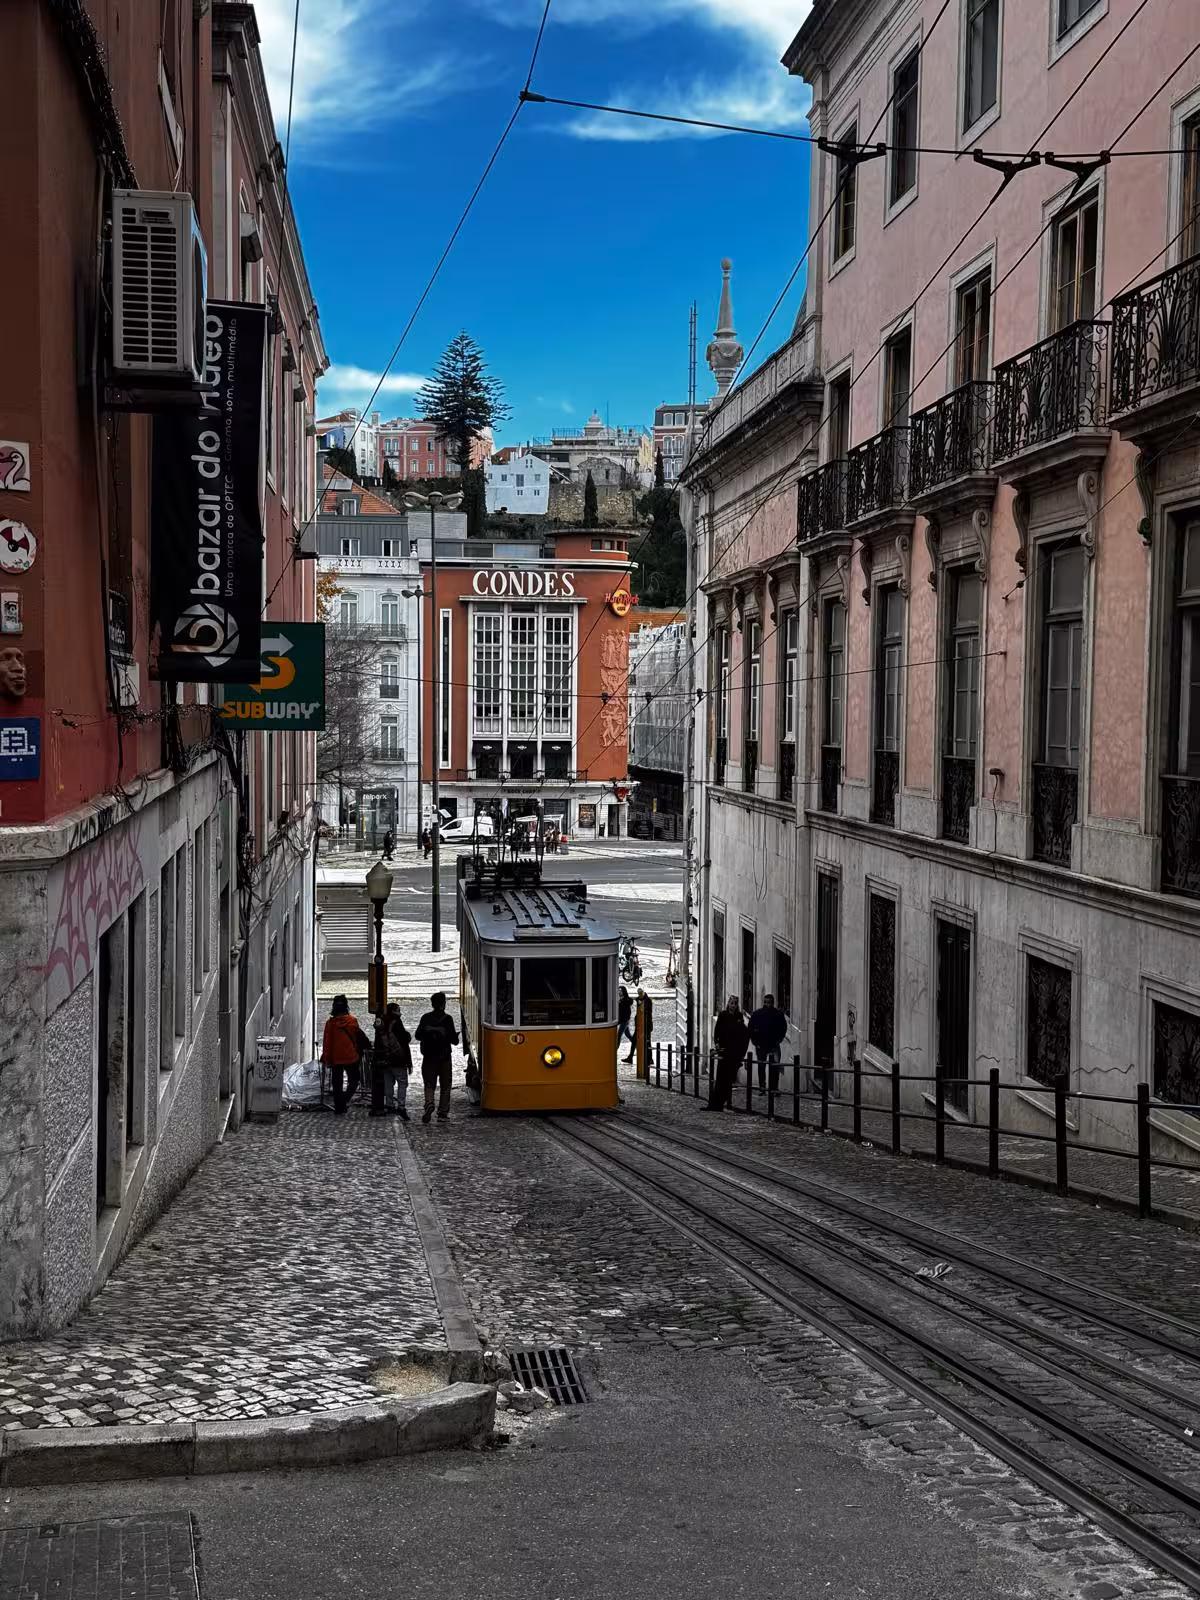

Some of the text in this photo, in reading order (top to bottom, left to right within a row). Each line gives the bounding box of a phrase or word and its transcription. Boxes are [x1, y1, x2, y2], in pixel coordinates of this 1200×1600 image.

[190, 429, 221, 478] do
[223, 474, 234, 511] OPTEC
[189, 487, 221, 596] bazar
[224, 572, 235, 597] Uma
[472, 570, 575, 596] CONDES
[604, 592, 623, 603] Hard
[217, 701, 321, 720] SUBWAY
